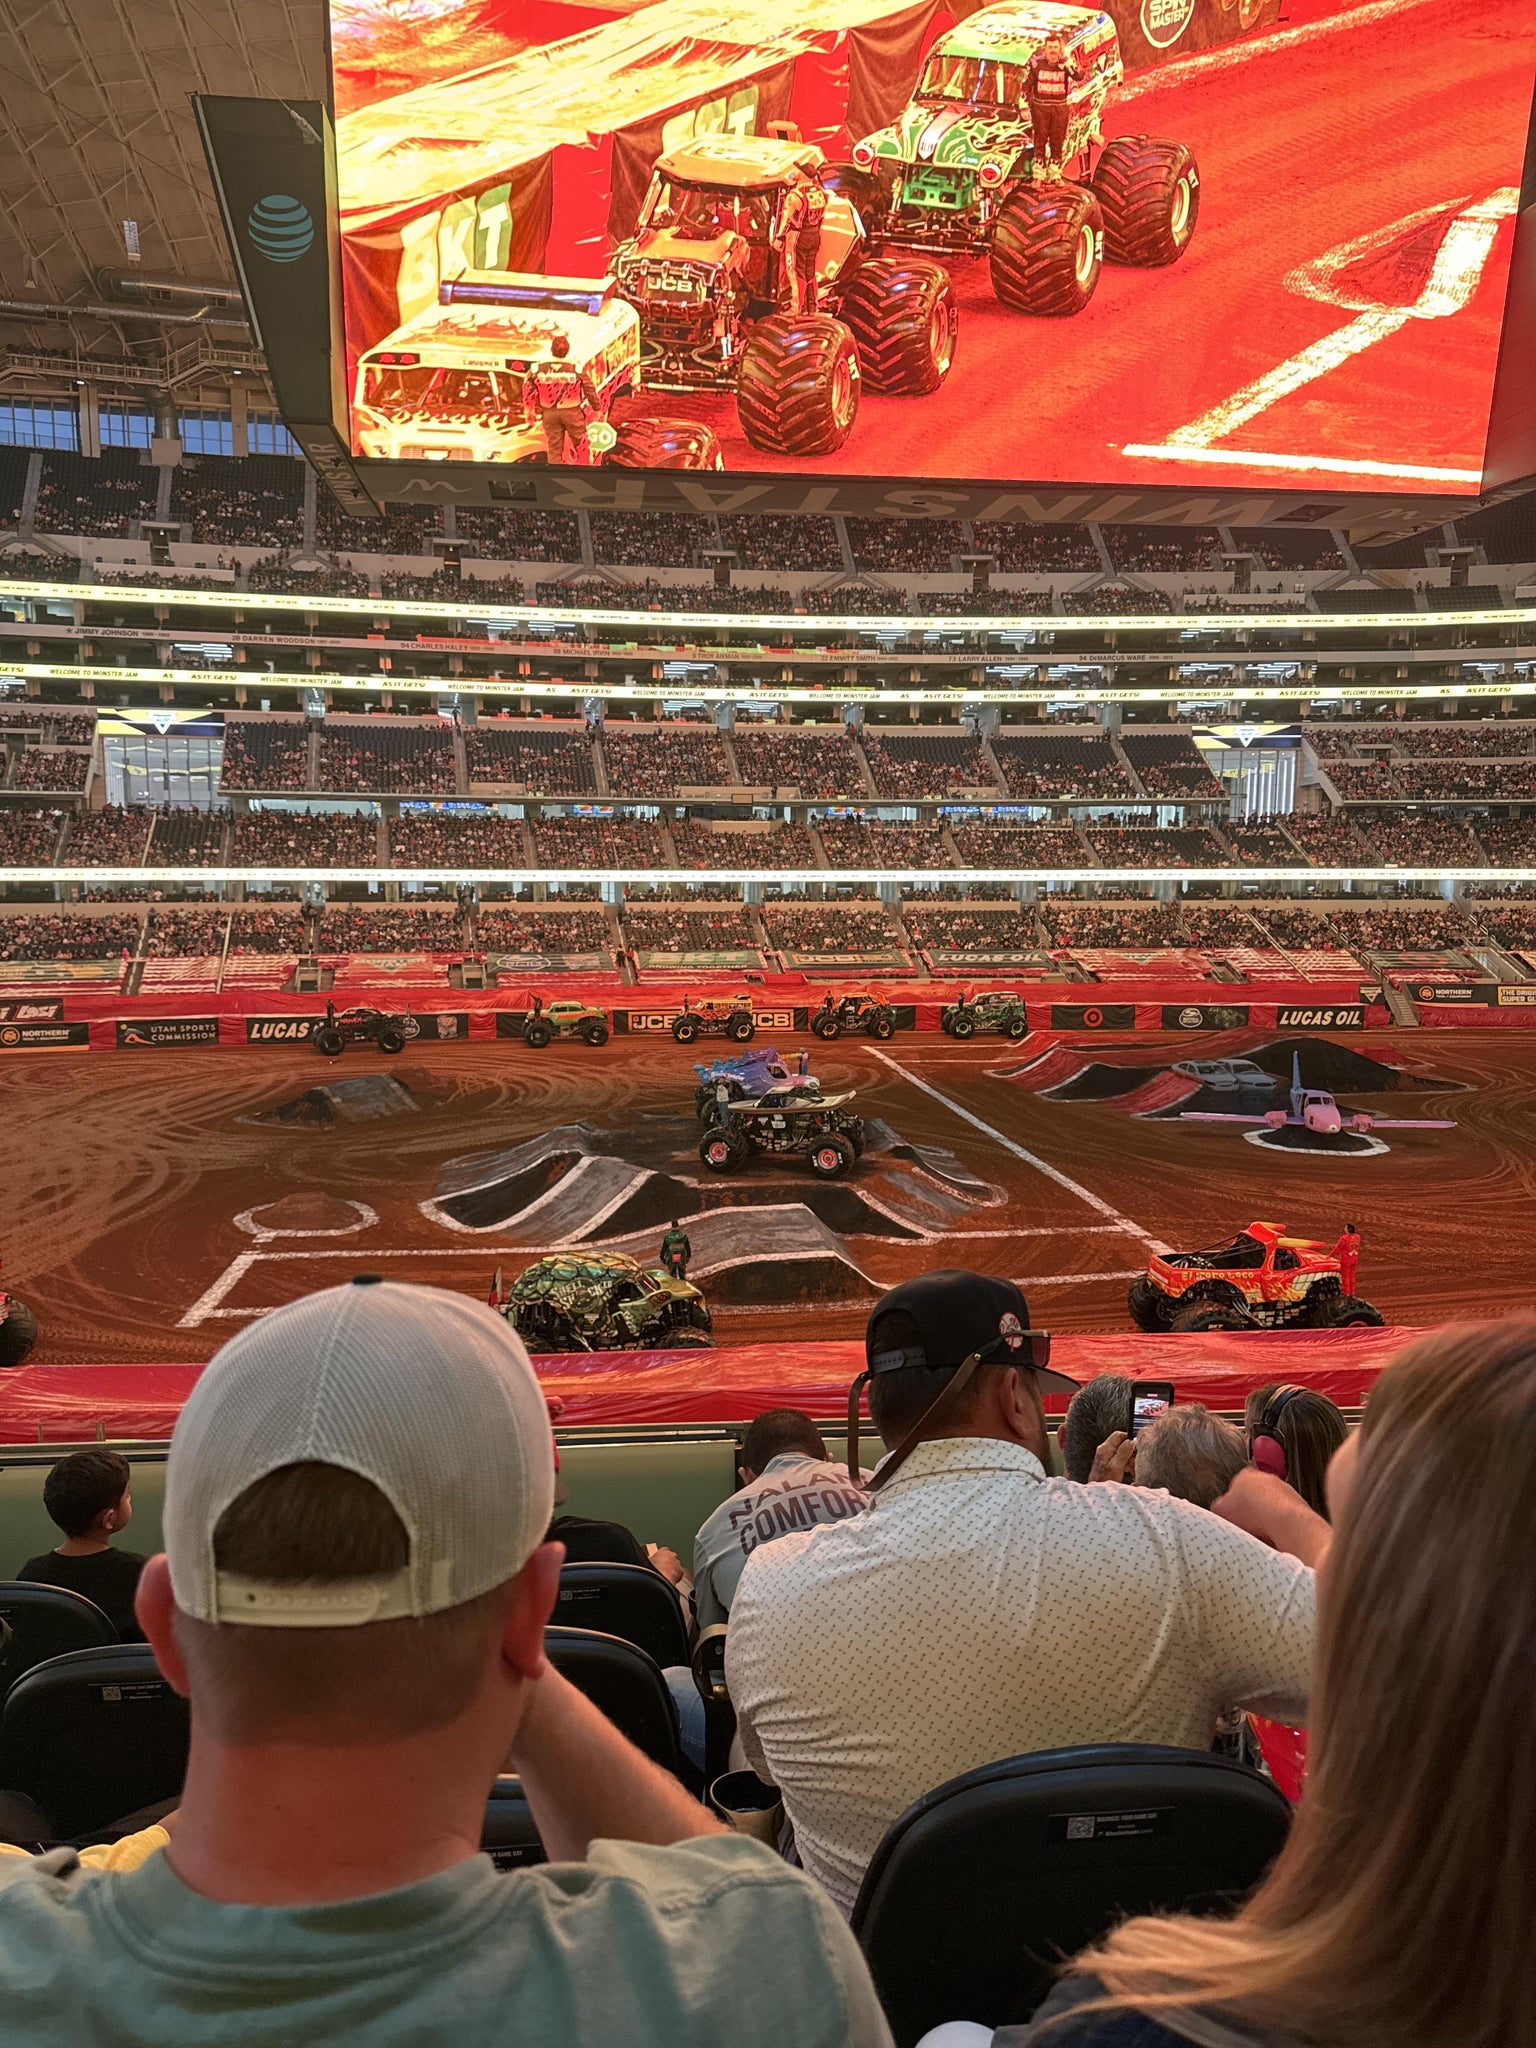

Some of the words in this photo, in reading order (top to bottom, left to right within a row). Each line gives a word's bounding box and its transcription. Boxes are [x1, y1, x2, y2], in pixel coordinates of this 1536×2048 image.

[1150, 0, 1186, 17] SPIN
[649, 278, 693, 292] JCB
[551, 477, 1277, 527] WINSTAR
[633, 1015, 675, 1029] JCB
[1279, 1011, 1333, 1026] LUCAS
[1336, 1011, 1361, 1025] OIL
[22, 1029, 69, 1037] NORTHERN
[151, 1025, 177, 1033] UTAH
[180, 1024, 216, 1032] SPORTS
[251, 1022, 311, 1039] LUCAS
[151, 1032, 216, 1041] COMMISSION
[740, 1488, 870, 1555] COMFOR
